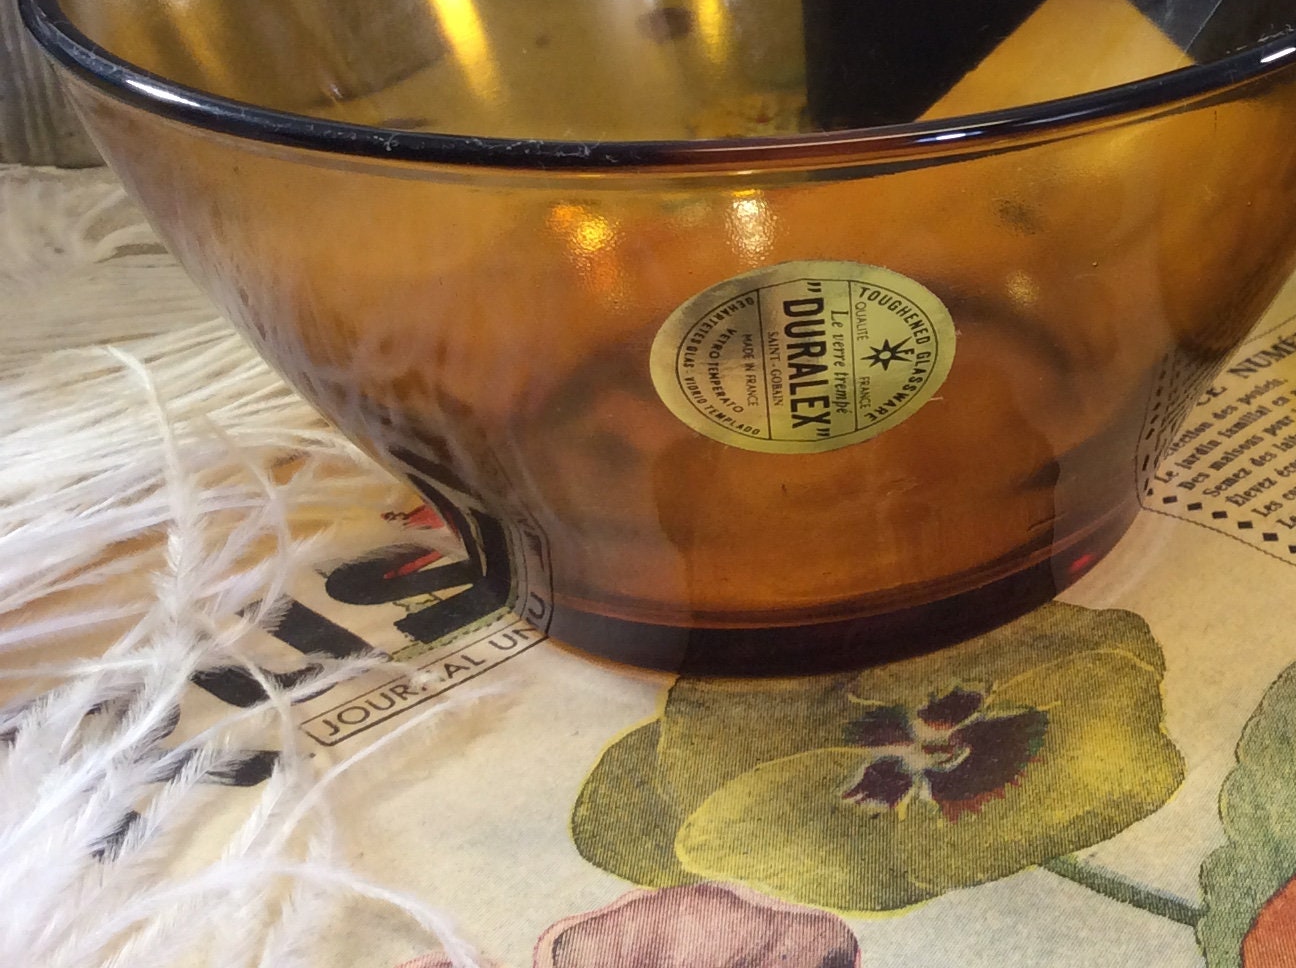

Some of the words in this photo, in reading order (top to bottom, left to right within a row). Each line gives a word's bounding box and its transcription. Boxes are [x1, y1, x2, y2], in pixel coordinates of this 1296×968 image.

[830, 310, 849, 328] Le
[857, 287, 931, 345] TOUGHENED
[708, 328, 738, 360] VETRO
[742, 334, 755, 360] MADE
[832, 334, 845, 368] verre
[744, 363, 756, 371] IN
[684, 377, 708, 404] VIDRIO
[707, 362, 744, 414] TEMPERATO
[745, 375, 760, 407] FRANCE
[833, 371, 853, 414] trempé
[857, 376, 871, 409] FRANCE
[862, 352, 931, 422] GLASSWARE
[1212, 404, 1239, 421] des
[1154, 469, 1179, 484] Le
[1175, 439, 1222, 470] jardin
[1177, 472, 1211, 491] Des
[1208, 435, 1264, 471] maisons
[1262, 415, 1295, 437] pour
[1202, 468, 1252, 498] Semez
[1250, 451, 1278, 467] des
[1251, 500, 1284, 518] Les
[321, 653, 487, 737] JOURAL
